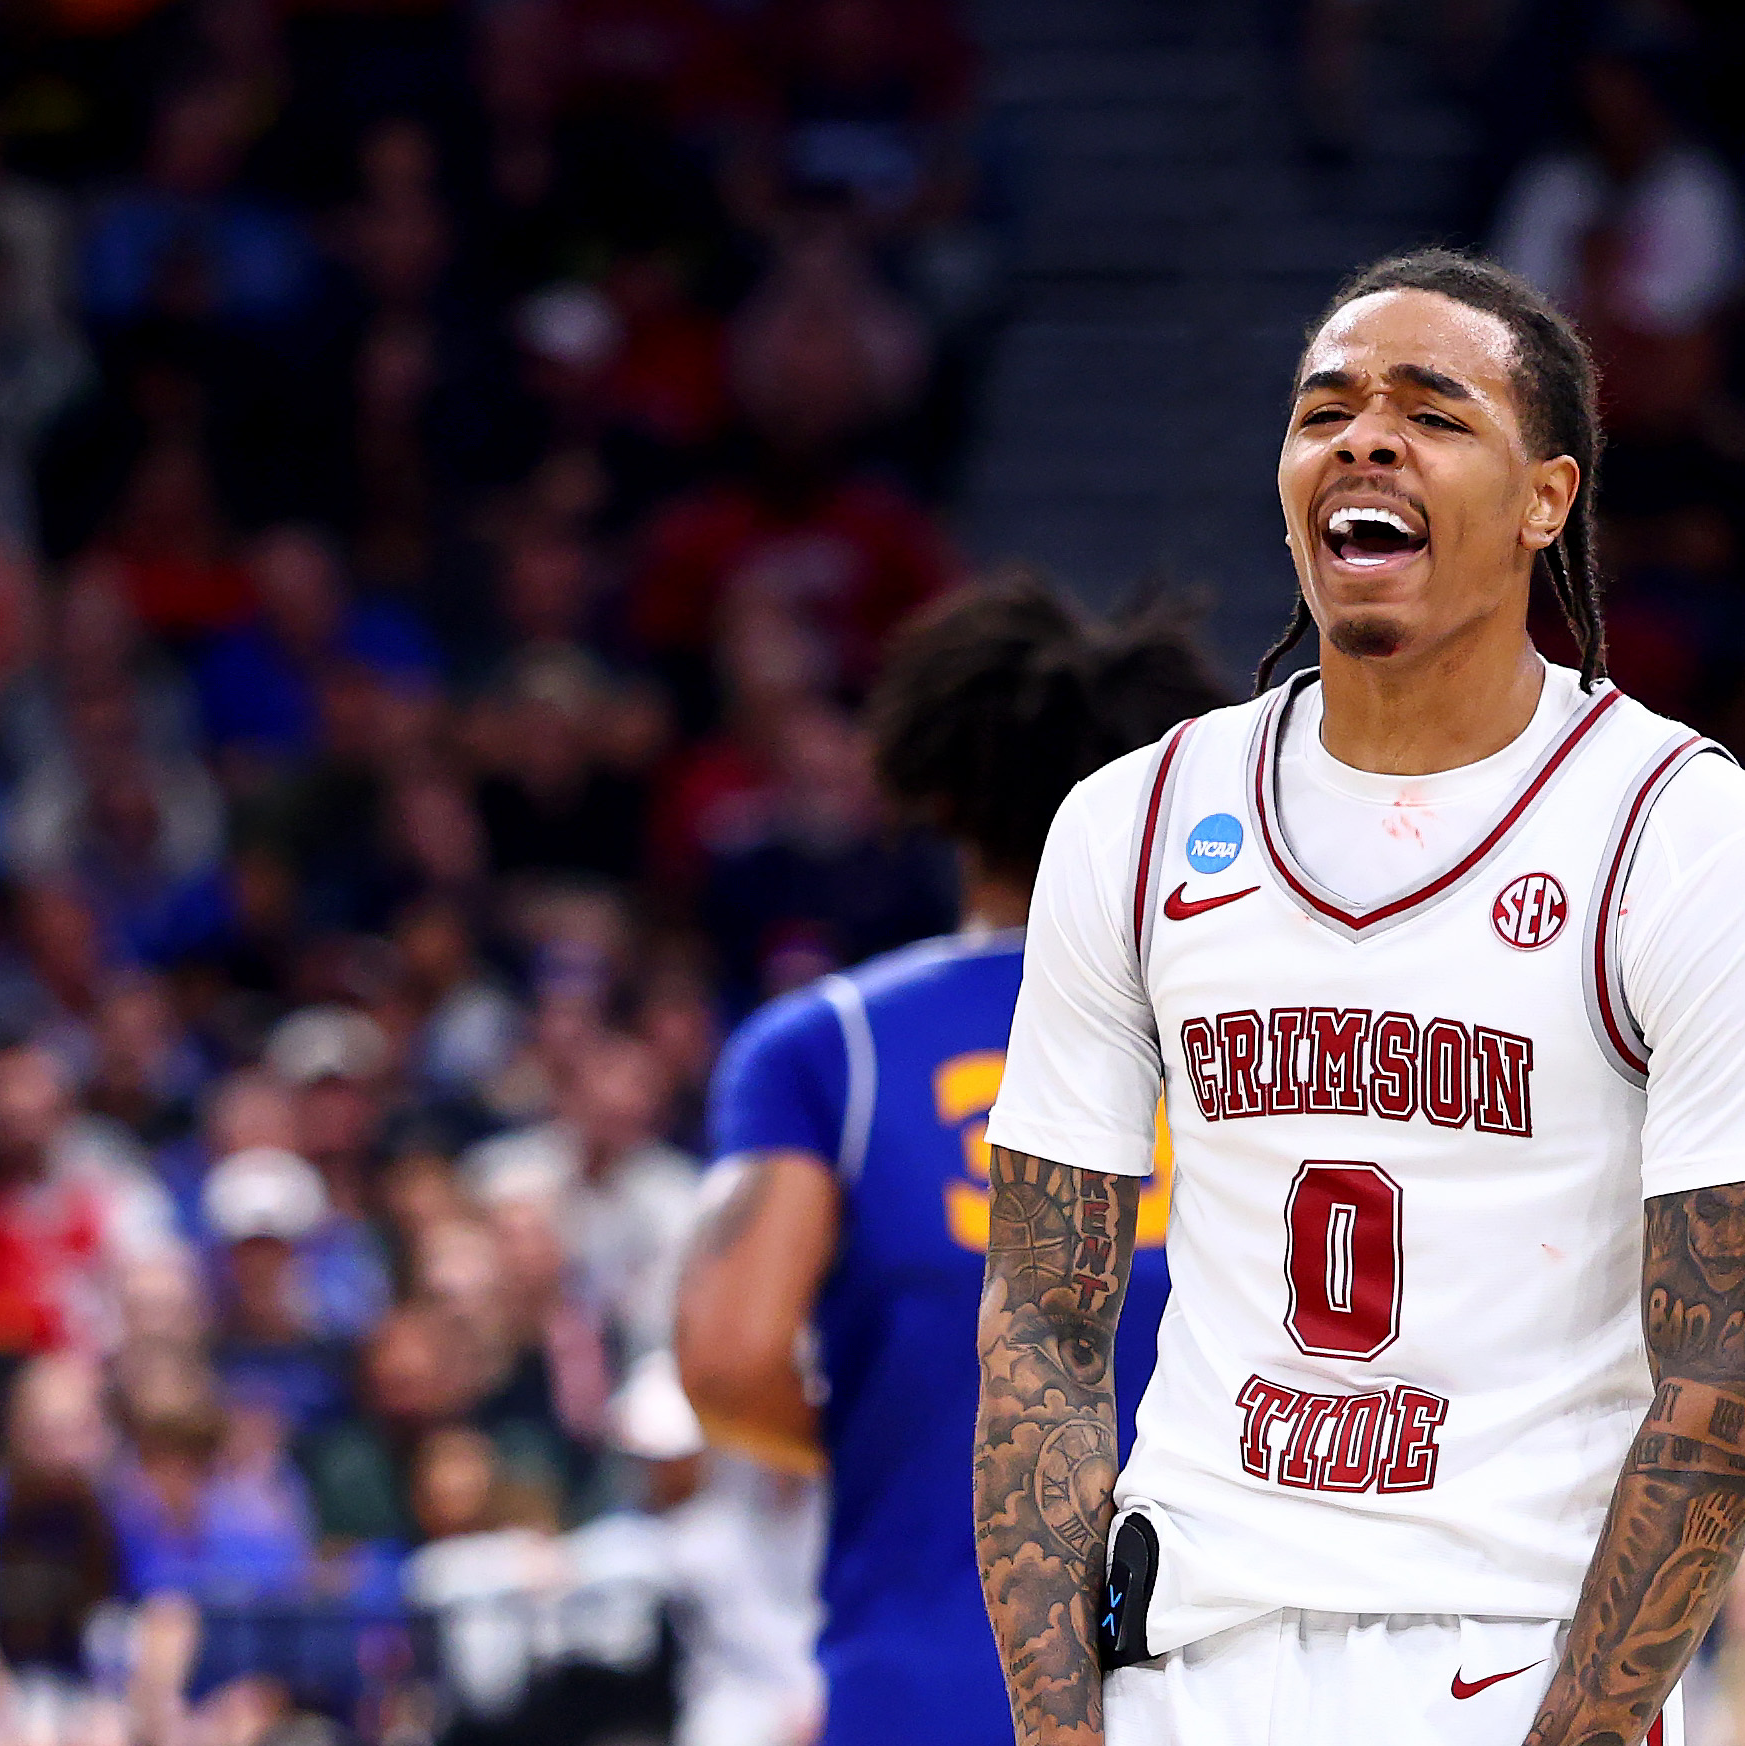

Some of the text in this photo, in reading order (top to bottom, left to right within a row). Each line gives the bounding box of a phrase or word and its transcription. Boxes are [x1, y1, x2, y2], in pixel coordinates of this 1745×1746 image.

[1190, 839, 1237, 859] NCAA
[1495, 876, 1564, 945] SEC
[1180, 1006, 1534, 1138] CRIMSON
[1283, 1159, 1404, 1362] 0
[1235, 1374, 1450, 1495] TIDE
